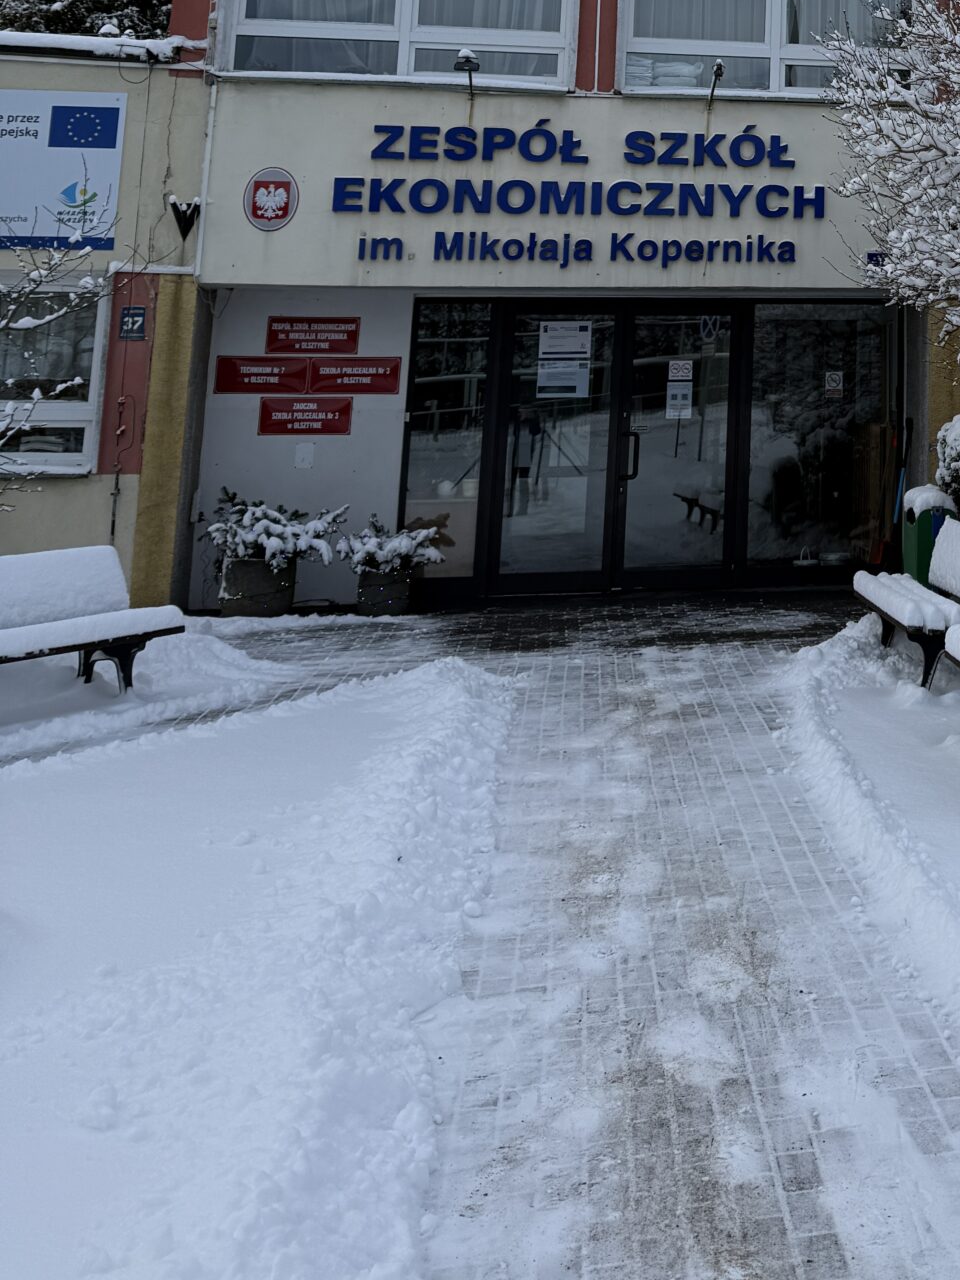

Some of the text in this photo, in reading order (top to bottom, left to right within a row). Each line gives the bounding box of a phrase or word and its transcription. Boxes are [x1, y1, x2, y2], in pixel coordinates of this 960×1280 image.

[7, 114, 40, 124] przez
[371, 119, 795, 169] ZESPÓŁ SZKÓŁ
[332, 178, 826, 219] EKONOMICZNYCH
[434, 231, 594, 268] Mikołaja
[610, 233, 797, 269] Kopernika
[122, 316, 144, 330] 37
[310, 322, 356, 331] EKONOMICZNYCH
[316, 332, 348, 340] KOPERNIKA
[300, 341, 330, 349] OLSZTYNIE
[240, 366, 272, 374] TECHNIKUM
[319, 367, 341, 375] SZKOŁA
[342, 367, 377, 375] POLICEALNA
[377, 367, 385, 375] Nr
[250, 376, 280, 384] OLSZTYNIE
[342, 376, 372, 384] OLSZTYNIE
[292, 402, 318, 410] ZAOCZNA
[271, 412, 292, 420] SZKOŁA
[293, 412, 326, 420] POLICEALNA
[326, 412, 334, 420] Nr
[293, 421, 323, 429] OLSZTYNIE
